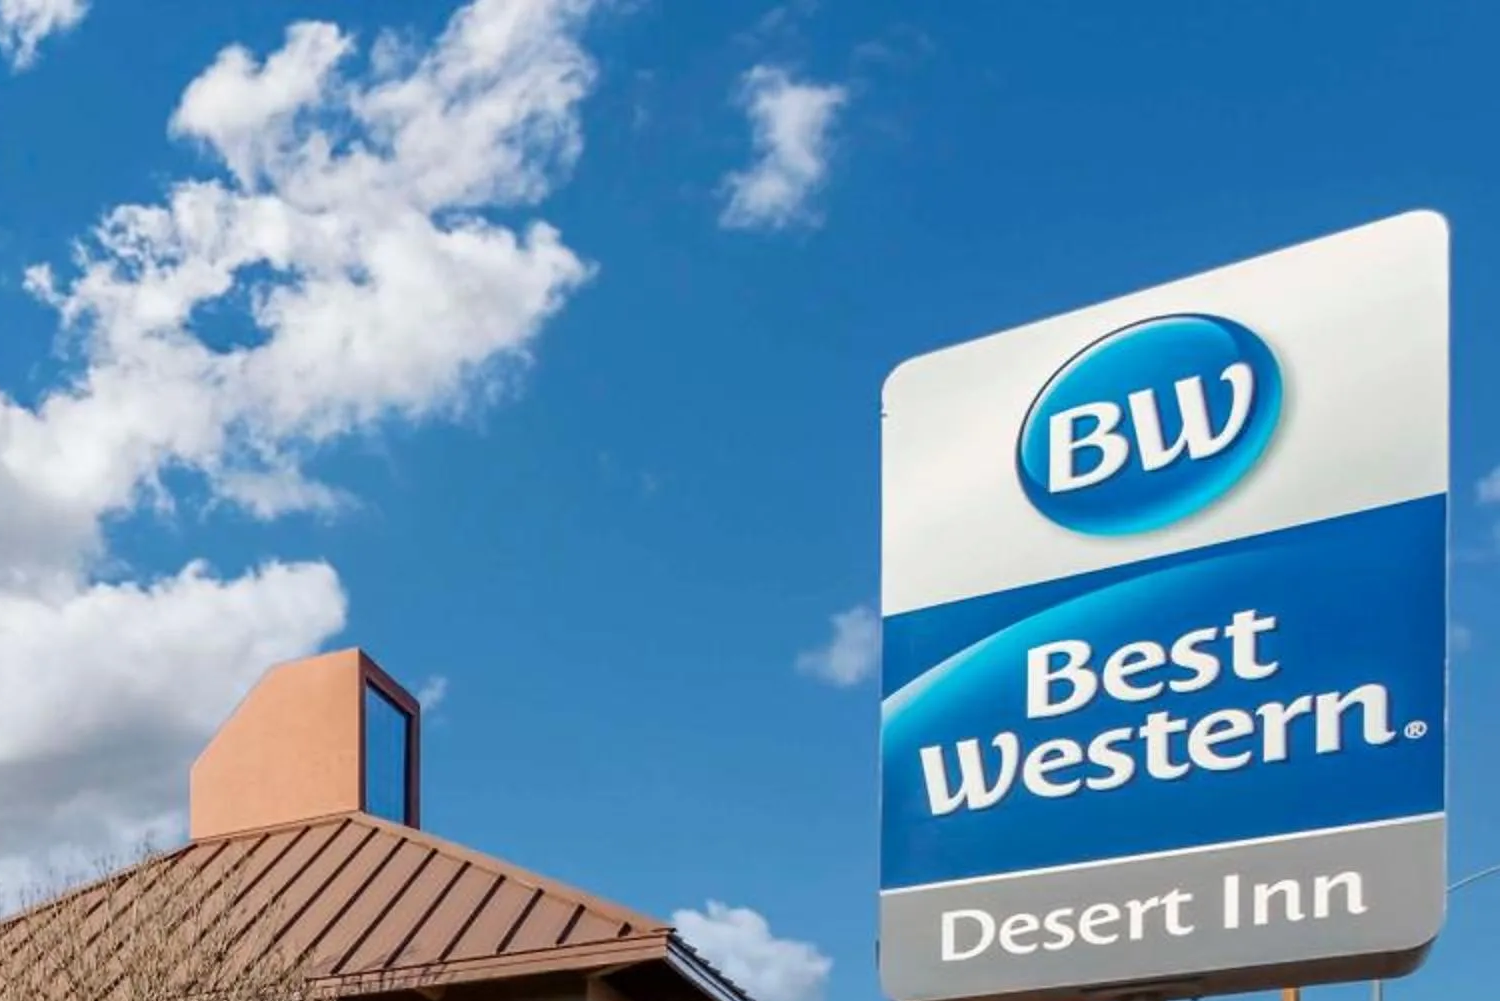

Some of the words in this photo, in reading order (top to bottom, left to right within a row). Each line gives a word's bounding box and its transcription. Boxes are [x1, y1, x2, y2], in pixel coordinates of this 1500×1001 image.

[1048, 362, 1256, 493] BW
[1026, 608, 1278, 719] Best
[940, 889, 1193, 962] Desert
[1223, 867, 1368, 930] Inn
